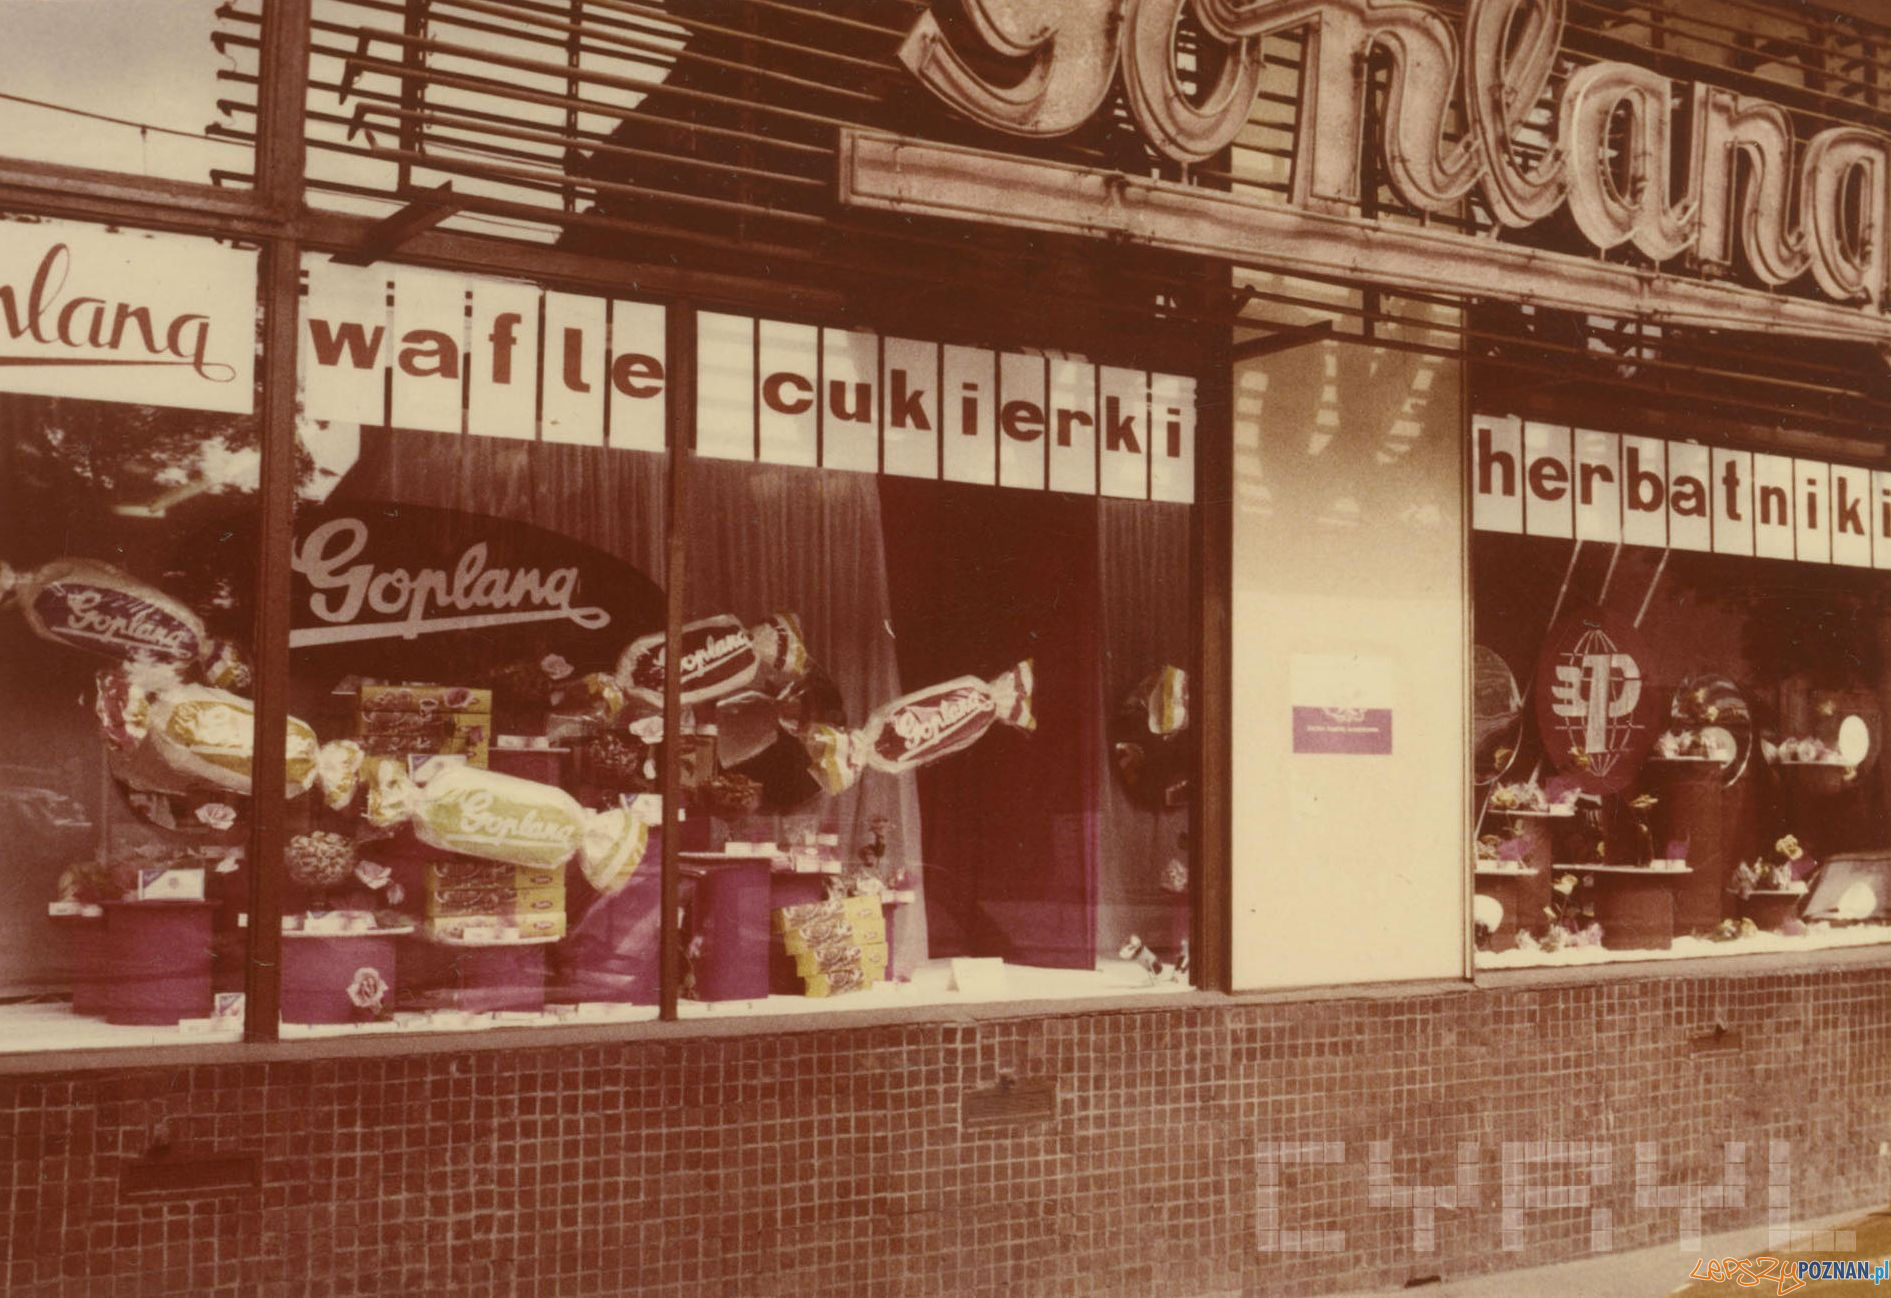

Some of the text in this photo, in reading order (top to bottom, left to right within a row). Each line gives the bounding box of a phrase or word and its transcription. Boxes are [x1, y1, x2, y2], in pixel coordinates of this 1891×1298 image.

[308, 312, 1182, 459] wafle cukierki
[1477, 428, 1891, 539] herbatniki
[290, 517, 611, 640] Goplana
[66, 590, 193, 659] Goplana
[652, 630, 753, 678] oplana
[458, 789, 575, 848] Goplana
